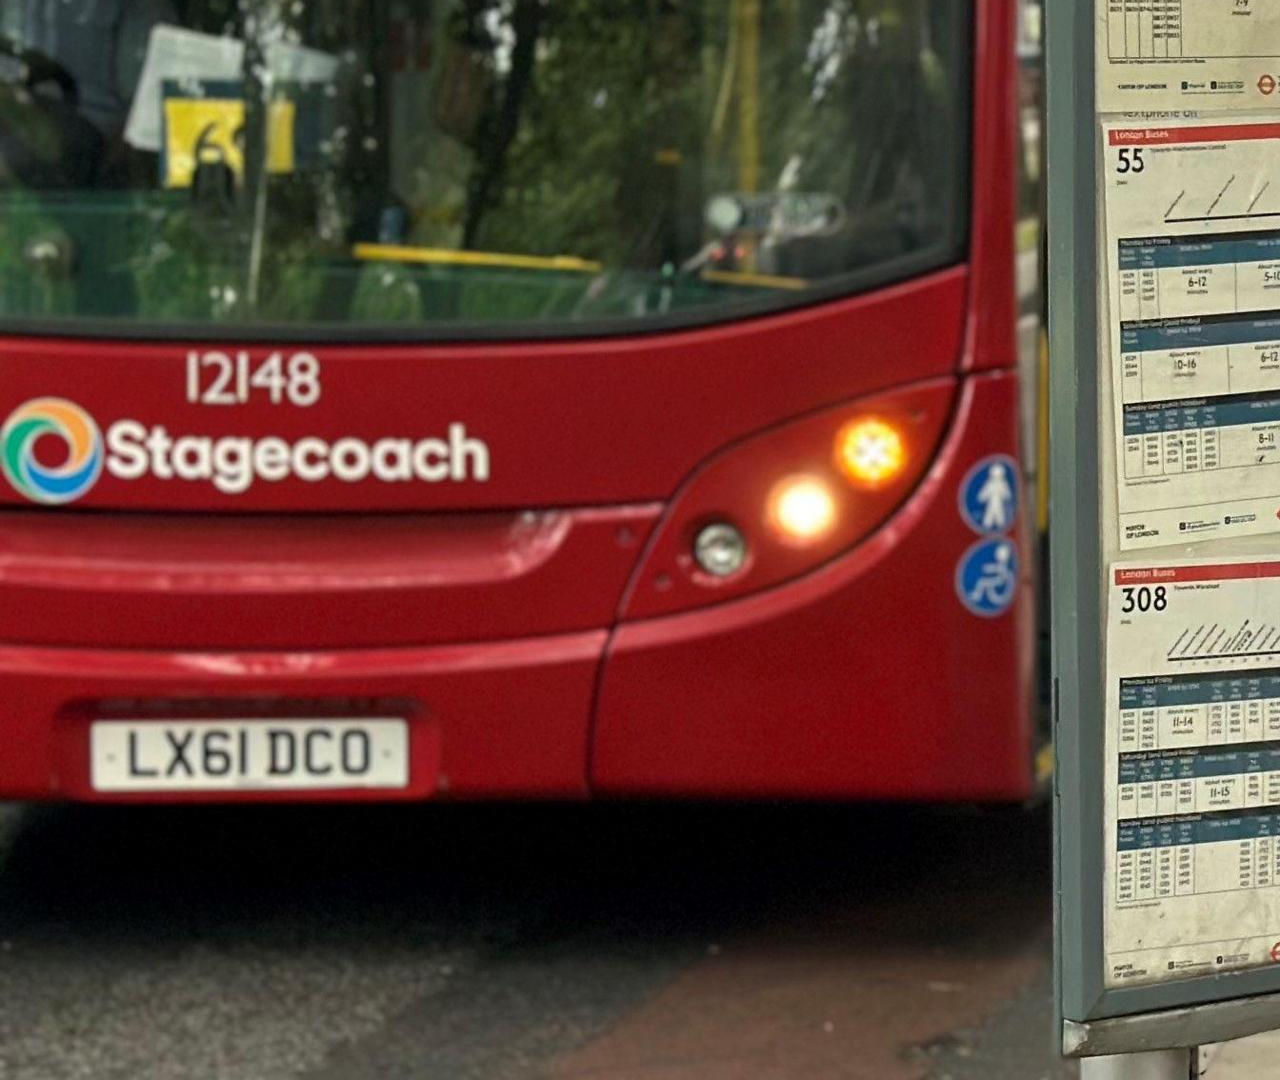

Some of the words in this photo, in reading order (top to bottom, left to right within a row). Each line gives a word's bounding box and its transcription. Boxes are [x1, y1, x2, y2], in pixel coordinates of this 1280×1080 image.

[1115, 131, 1144, 141] London
[1116, 148, 1144, 173] 55
[1187, 276, 1208, 287] 6-12
[1260, 351, 1279, 362] 6-12
[1173, 359, 1197, 370] 10-16
[186, 350, 321, 407] 12148
[1258, 433, 1274, 444] 8-11
[105, 419, 490, 494] Stagecoach
[1134, 530, 1159, 538] LONDON
[1121, 570, 1151, 579] London
[1152, 569, 1176, 577] Buses
[1121, 586, 1167, 613] 308
[1173, 717, 1193, 728] 11-14
[128, 729, 248, 778] LX61
[1210, 786, 1231, 798] 11-15
